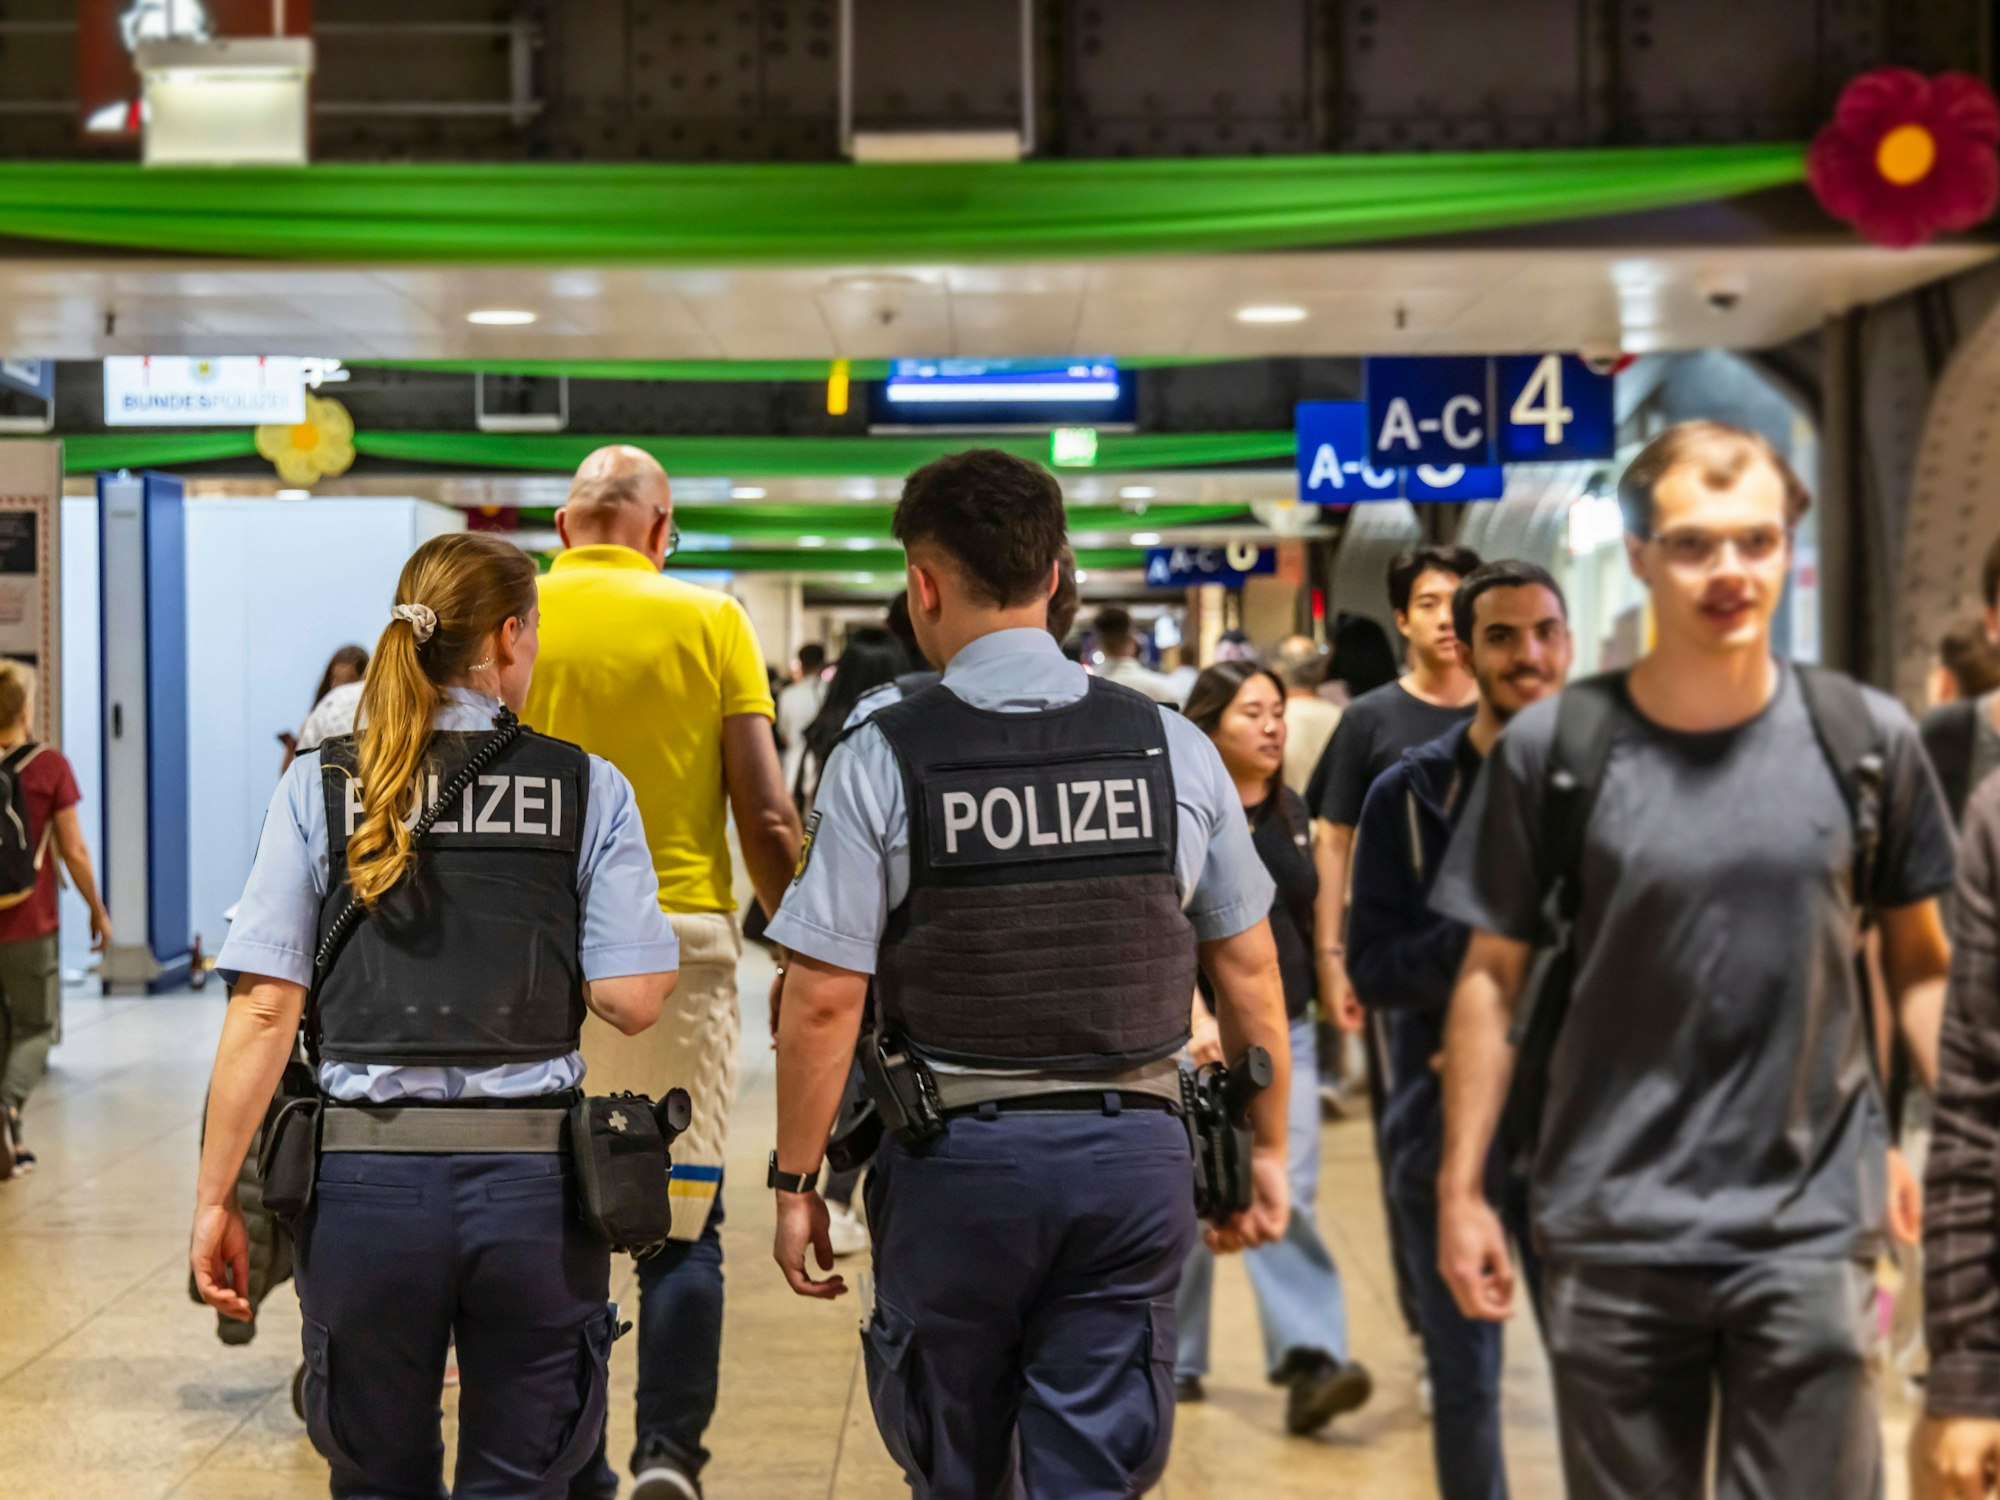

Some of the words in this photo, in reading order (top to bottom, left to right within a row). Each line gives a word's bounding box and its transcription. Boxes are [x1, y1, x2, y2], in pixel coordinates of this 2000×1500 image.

[1376, 395, 1483, 451] A-C
[1510, 353, 1574, 445] 4
[942, 778, 1153, 853] POLIZEI
